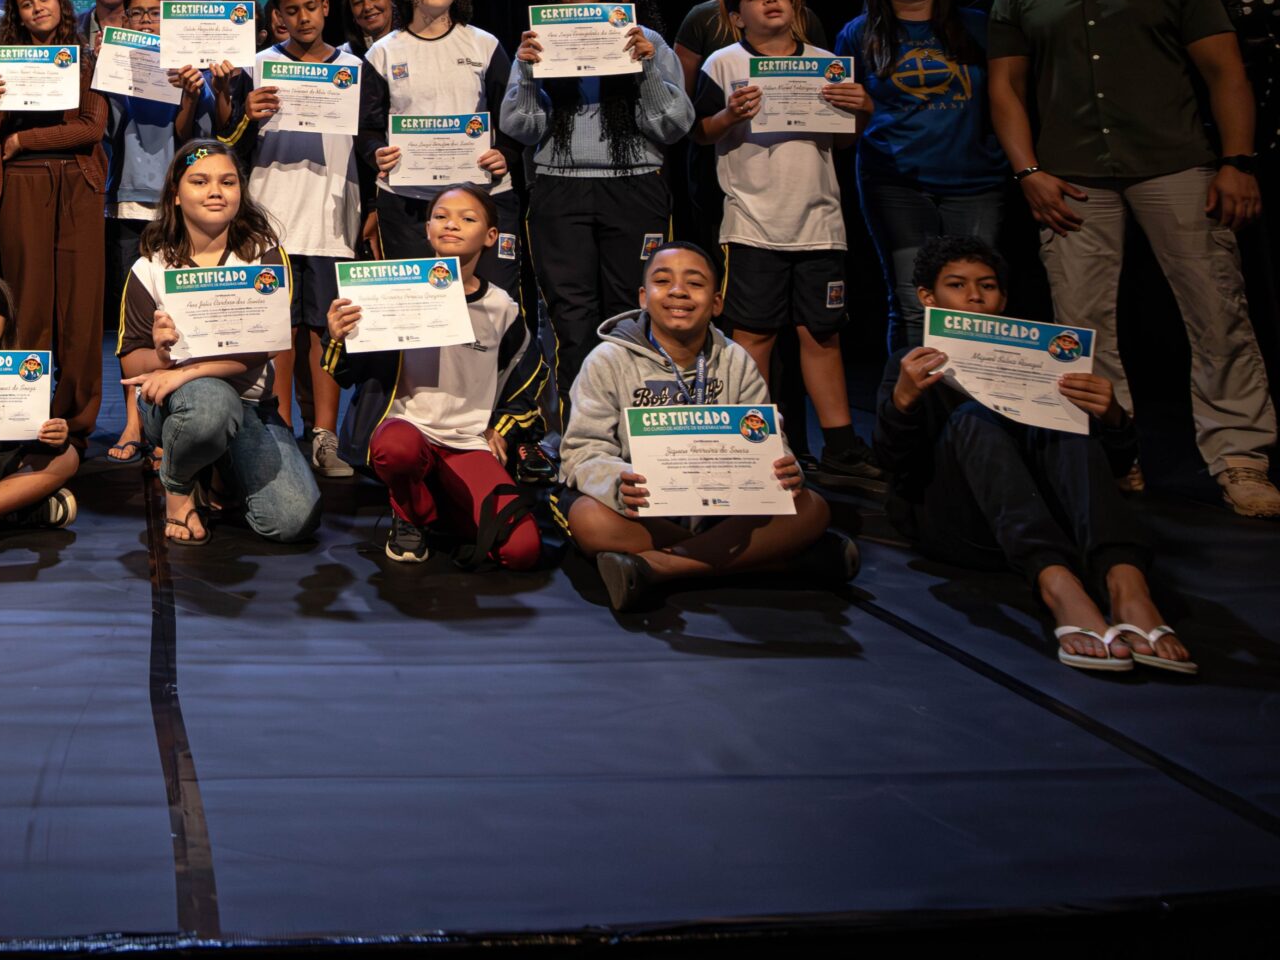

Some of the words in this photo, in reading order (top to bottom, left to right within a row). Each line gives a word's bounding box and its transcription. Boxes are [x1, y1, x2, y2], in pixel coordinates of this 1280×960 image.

[171, 5, 225, 14] CERTIFICADO
[541, 7, 602, 18] CERTIFICADO
[272, 64, 328, 76] CERTIFICADO
[758, 61, 818, 71] CERTIFICADO
[401, 118, 460, 128] CERTIFICADO
[350, 264, 420, 278] CERTIFICADO
[176, 270, 246, 285] CERTIFICADO
[944, 316, 1040, 340] CERTIFICADO
[642, 411, 730, 427] CERTIFICADO
